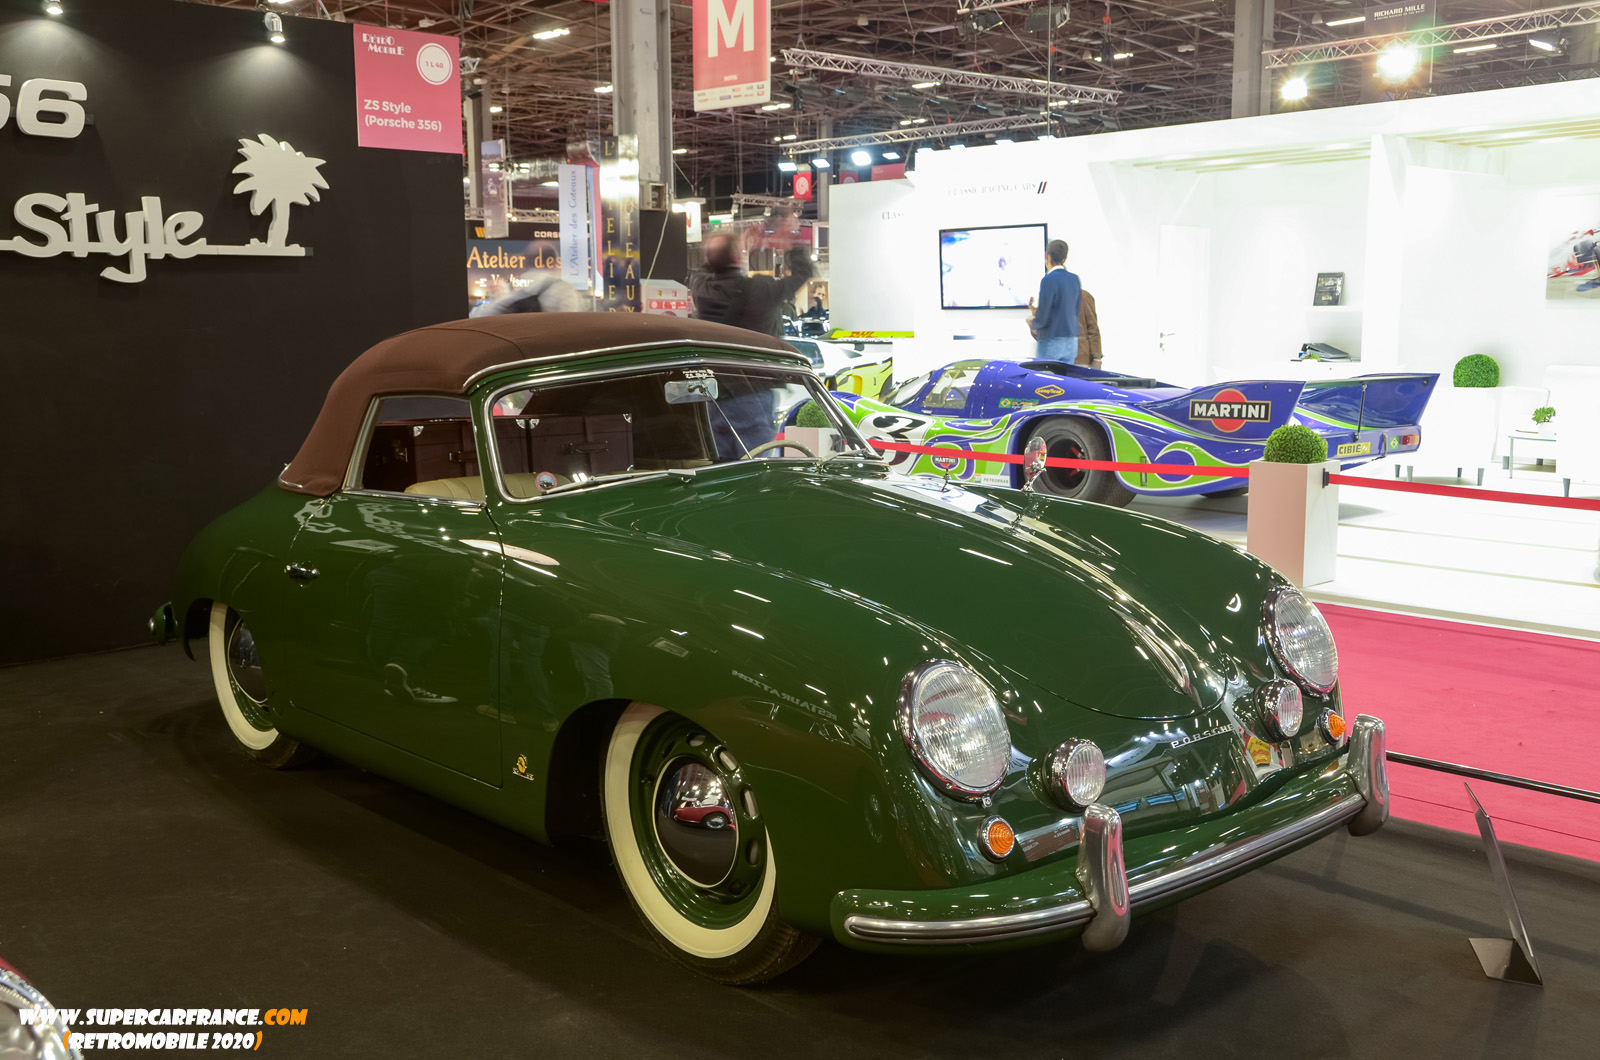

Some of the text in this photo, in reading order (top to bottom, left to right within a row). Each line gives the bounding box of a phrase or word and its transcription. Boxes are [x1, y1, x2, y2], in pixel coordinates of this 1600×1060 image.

[1374, 8, 1403, 17] RICHARD
[1404, 4, 1425, 12] MILLE
[707, 0, 755, 58] M
[364, 99, 412, 115] ZS Style
[365, 114, 442, 133] (Porsche 356)
[567, 169, 578, 208] Coteaux
[571, 211, 579, 229] des
[13, 192, 207, 284] Style
[466, 246, 526, 269] Atelier
[1193, 402, 1266, 419] MARTINI
[934, 456, 957, 464] MARTINI
[1170, 723, 1236, 749] PORSCHE
